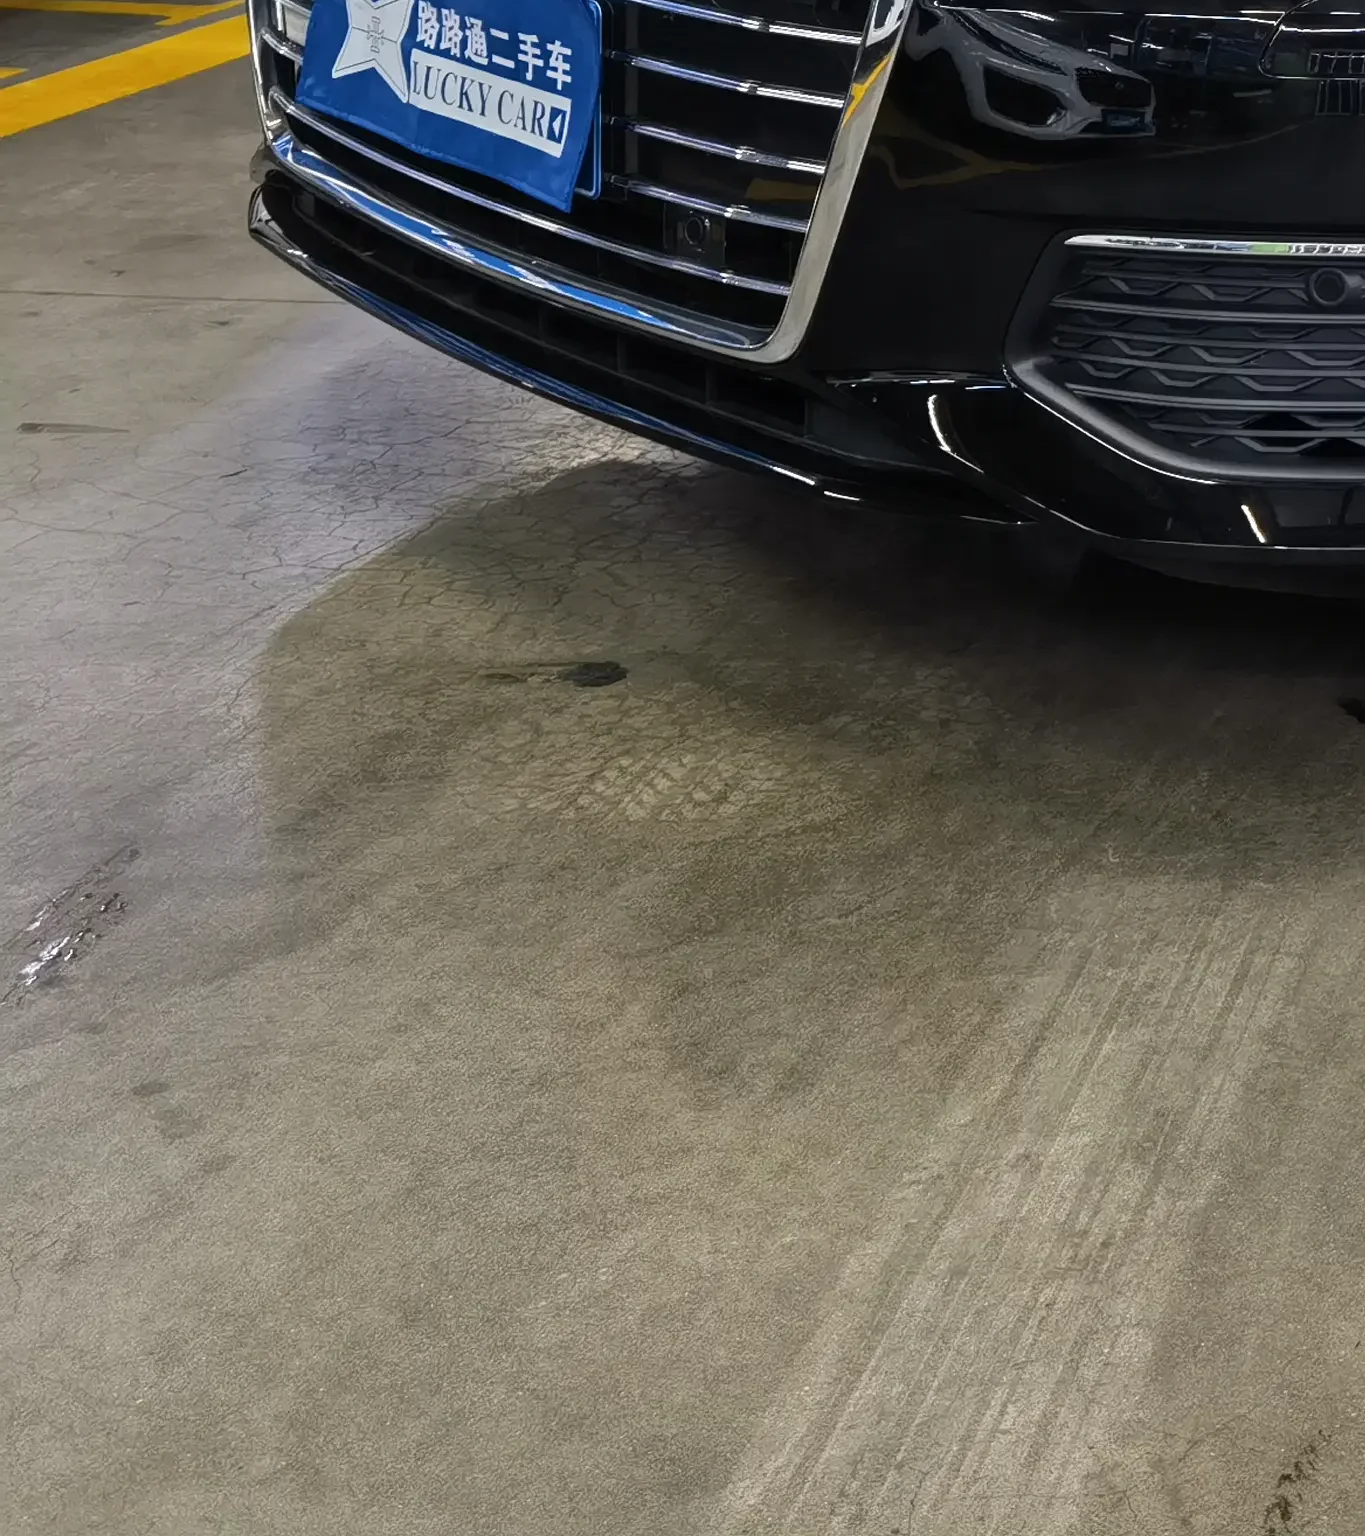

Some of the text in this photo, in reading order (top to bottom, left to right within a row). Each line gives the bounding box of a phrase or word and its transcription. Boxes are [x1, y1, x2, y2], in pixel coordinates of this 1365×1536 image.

[416, 0, 572, 91] 路路通二手车
[412, 61, 548, 141] LUCKY CAR
